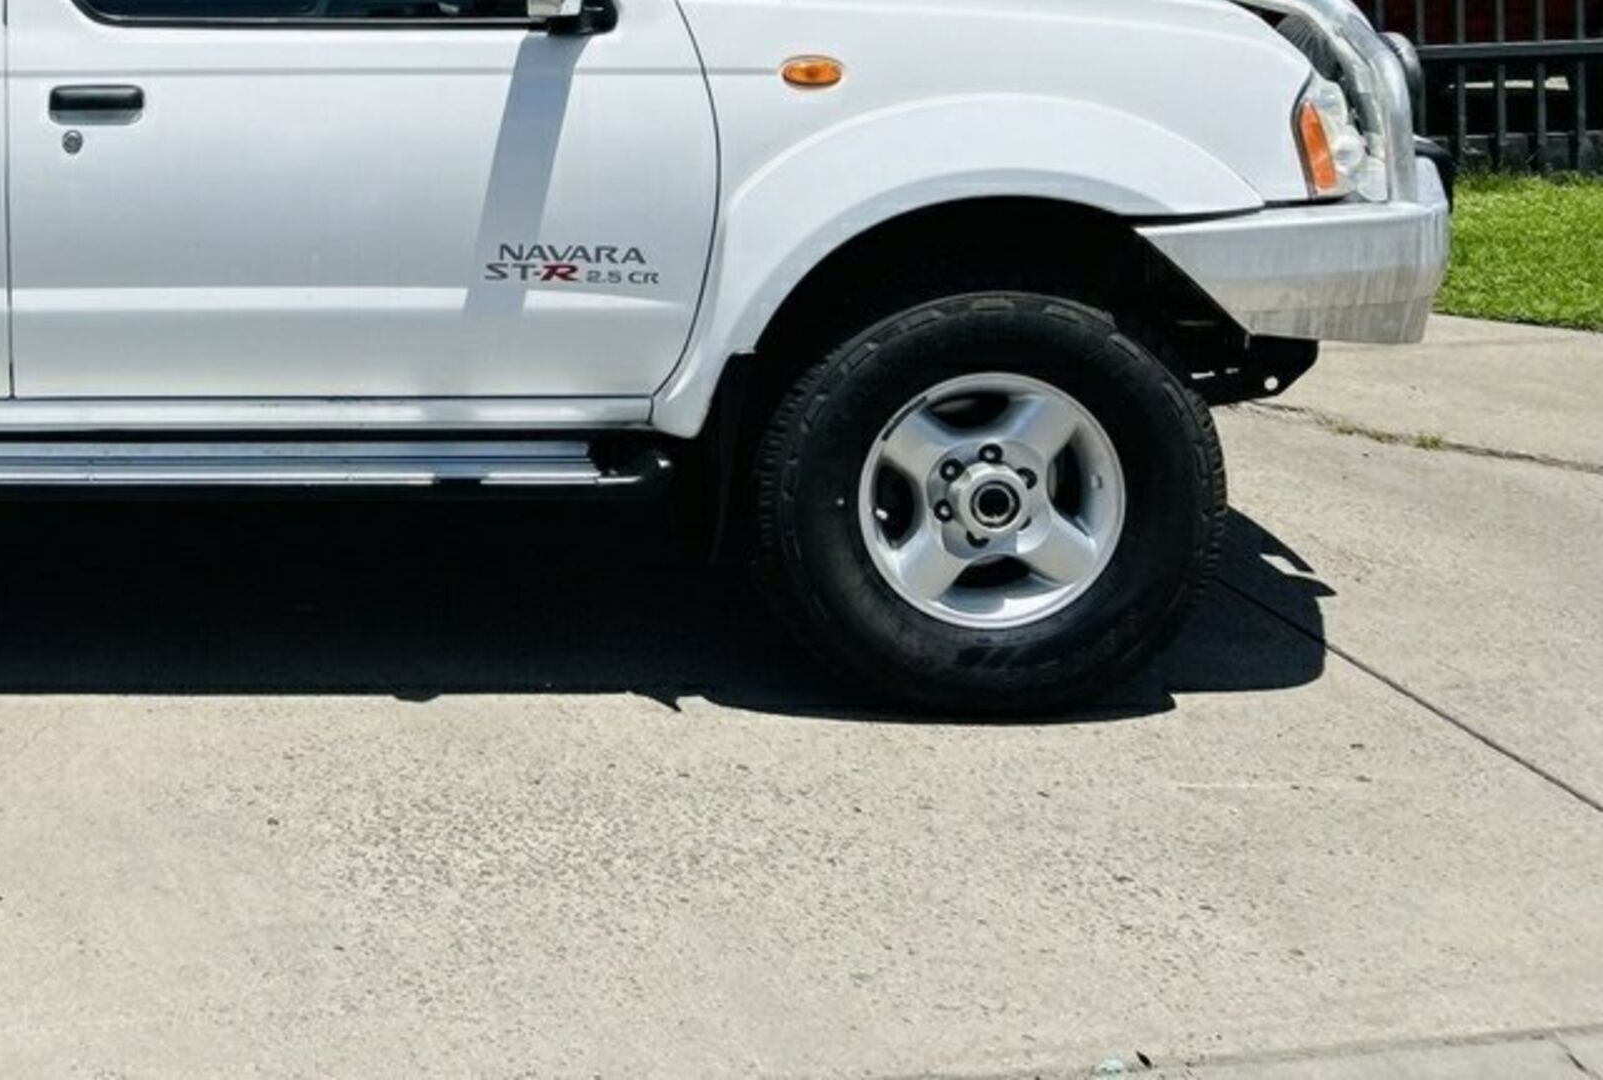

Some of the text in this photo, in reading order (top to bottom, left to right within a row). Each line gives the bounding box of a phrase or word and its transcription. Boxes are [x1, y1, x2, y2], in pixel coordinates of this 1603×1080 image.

[499, 243, 647, 264] NAVARA
[587, 270, 622, 284] 2.5
[628, 271, 659, 284] CR
